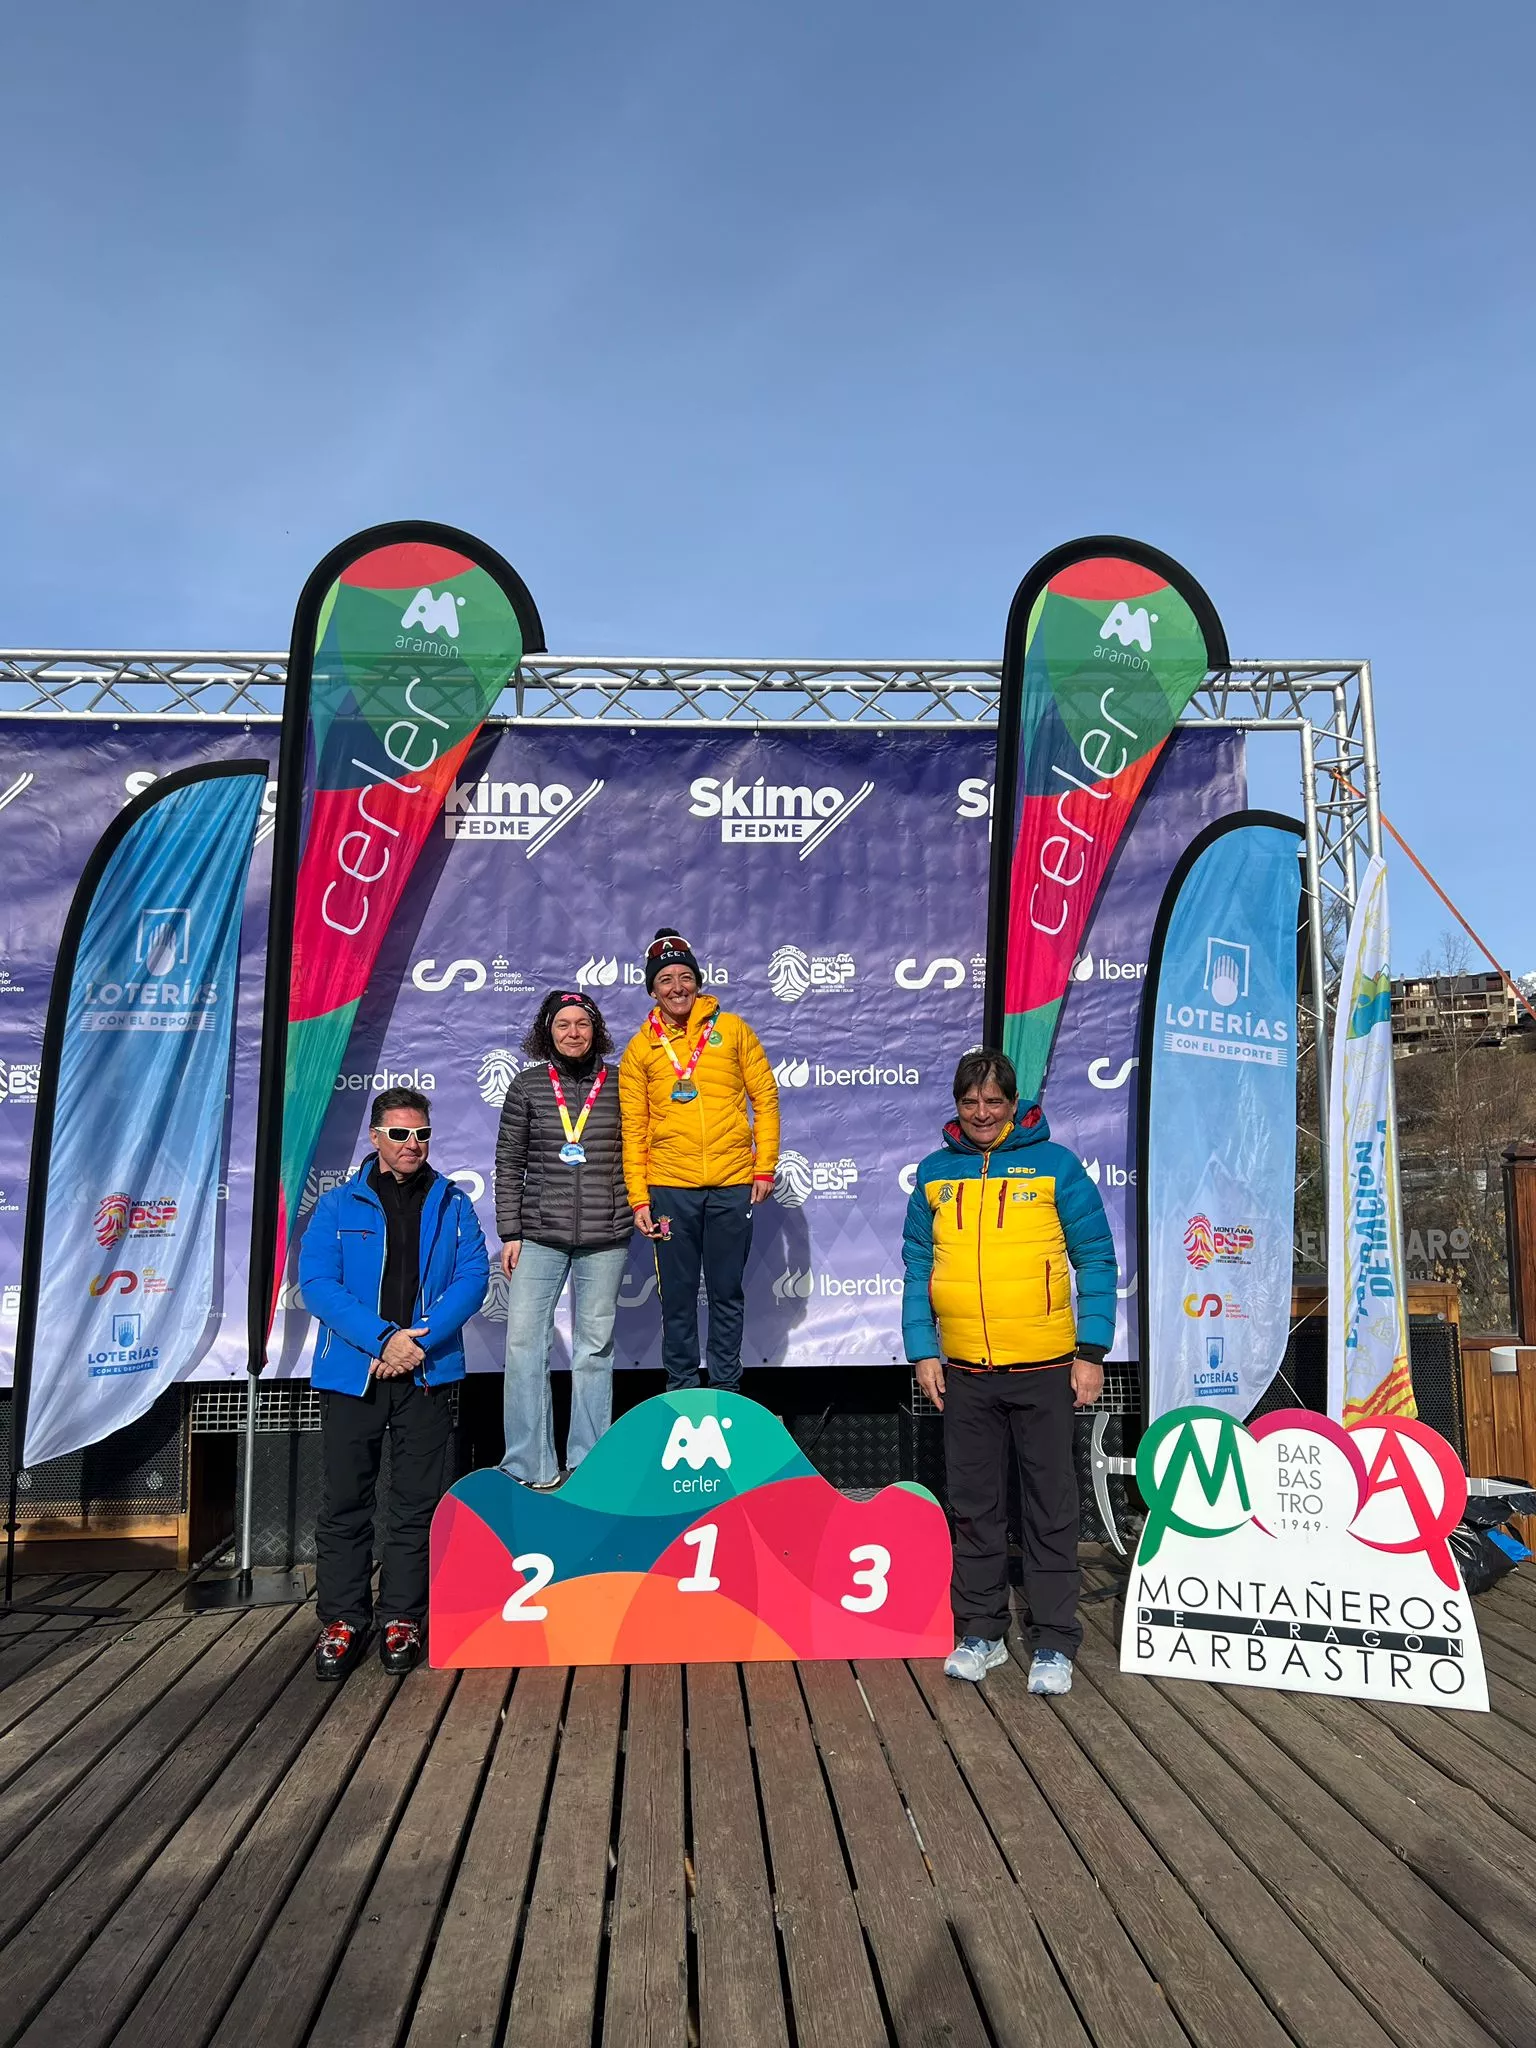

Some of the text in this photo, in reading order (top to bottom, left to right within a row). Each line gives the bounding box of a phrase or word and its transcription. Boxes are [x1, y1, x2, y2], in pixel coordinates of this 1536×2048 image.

[394, 635, 459, 659] aramon
[1093, 645, 1150, 672] aramon
[321, 677, 450, 935] cerler
[1029, 687, 1139, 935] cerler
[456, 821, 530, 835] FEDME
[731, 824, 803, 838] FEDME
[494, 971, 522, 980] Consejo
[1099, 958, 1148, 980] Iber
[494, 978, 524, 987] Superior
[98, 1016, 125, 1026] CON
[129, 1016, 145, 1026] EL
[1165, 1003, 1289, 1042] LOTERÍAS
[1176, 1038, 1273, 1060] CON EL DEPORTE
[815, 1064, 920, 1086] Iberdrola
[1013, 1191, 1038, 1201] ESP
[88, 1346, 159, 1364] LOTERÍAS
[1194, 1370, 1239, 1385] LOTERÍAS
[1276, 1443, 1321, 1465] BAR
[673, 1475, 721, 1493] cerler
[1277, 1468, 1322, 1490] BAS
[1277, 1493, 1323, 1515] TRO
[676, 1522, 721, 1593] 1
[501, 1552, 555, 1622] 2
[840, 1543, 892, 1614] 3
[1137, 1573, 1462, 1634] MONTAÑEROS
[1137, 1607, 1185, 1627] DE
[1137, 1626, 1465, 1695] BARBASTRO
